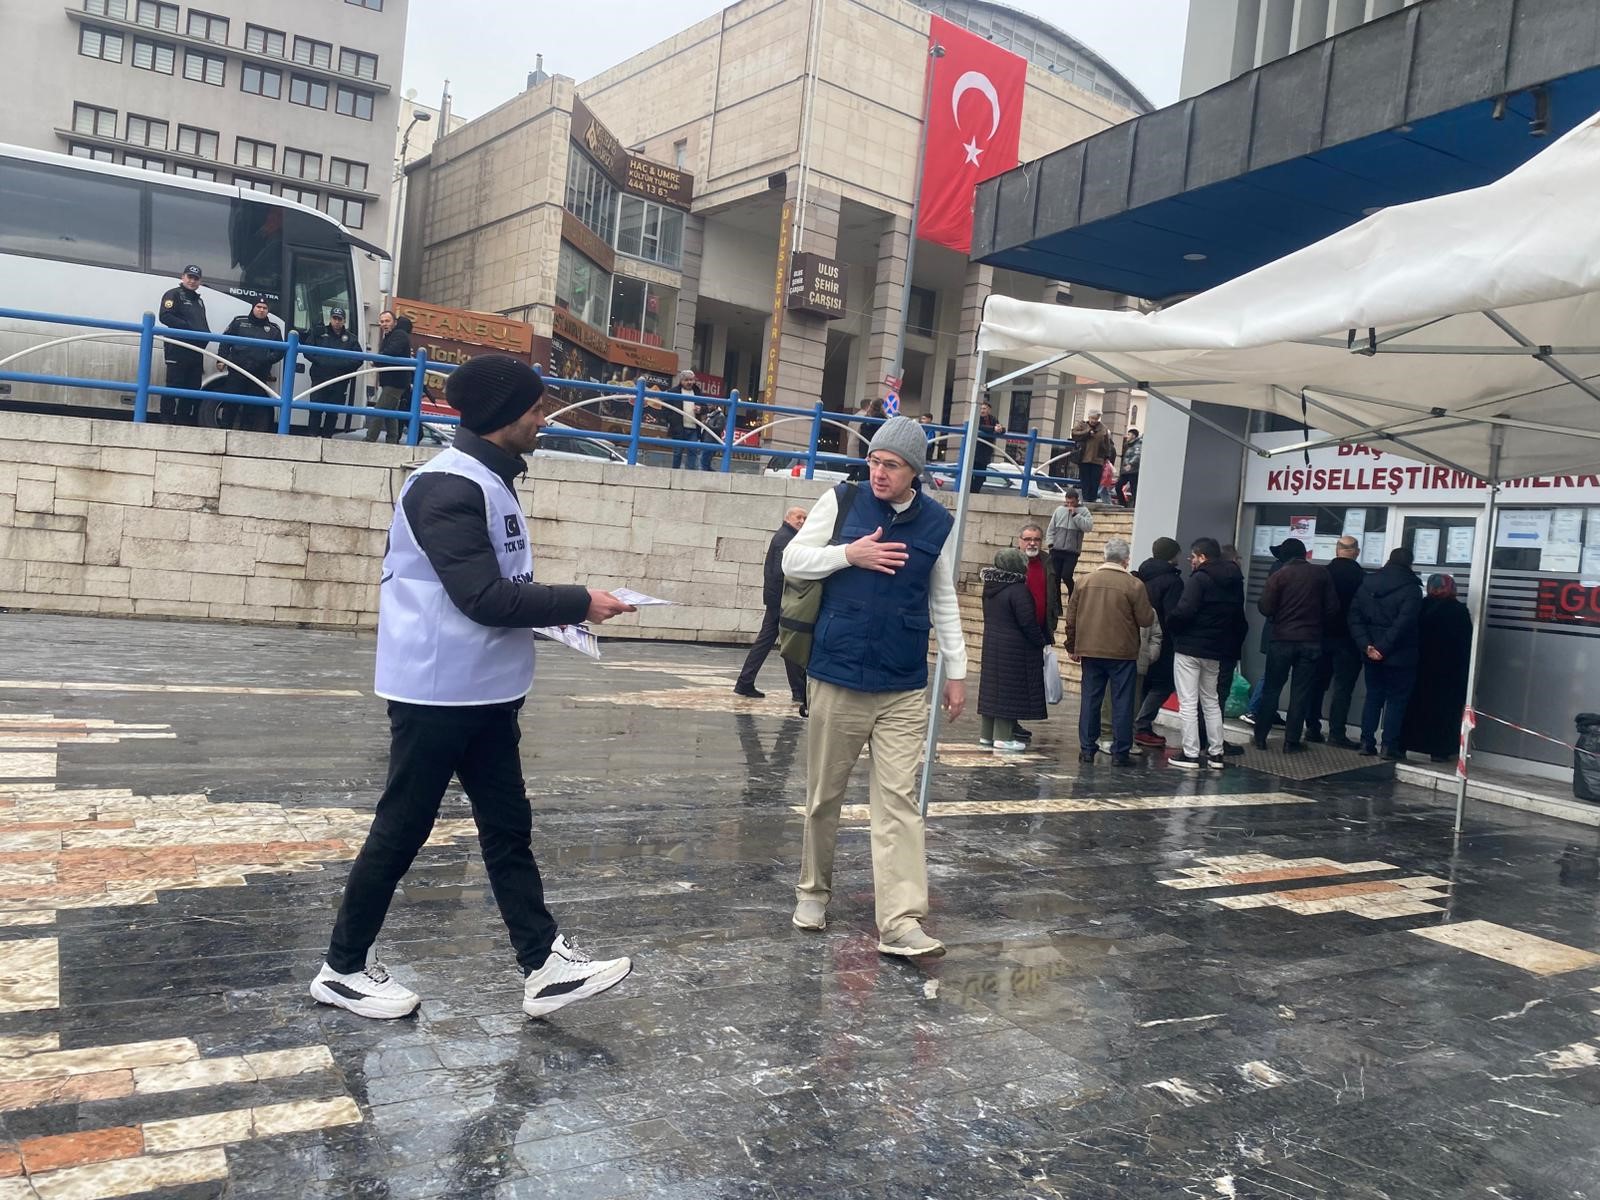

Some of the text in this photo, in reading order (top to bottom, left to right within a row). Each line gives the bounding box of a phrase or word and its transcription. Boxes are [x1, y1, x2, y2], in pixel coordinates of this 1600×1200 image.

[657, 168, 680, 183] UMRE
[628, 178, 644, 191] 444
[646, 183, 656, 195] 13
[779, 208, 790, 262] ULUS
[818, 262, 839, 279] ULUS
[229, 287, 256, 297] NOVO
[814, 277, 840, 295] ŞEHİR
[809, 291, 842, 310] ÇARŞISI
[504, 540, 518, 554] TCK
